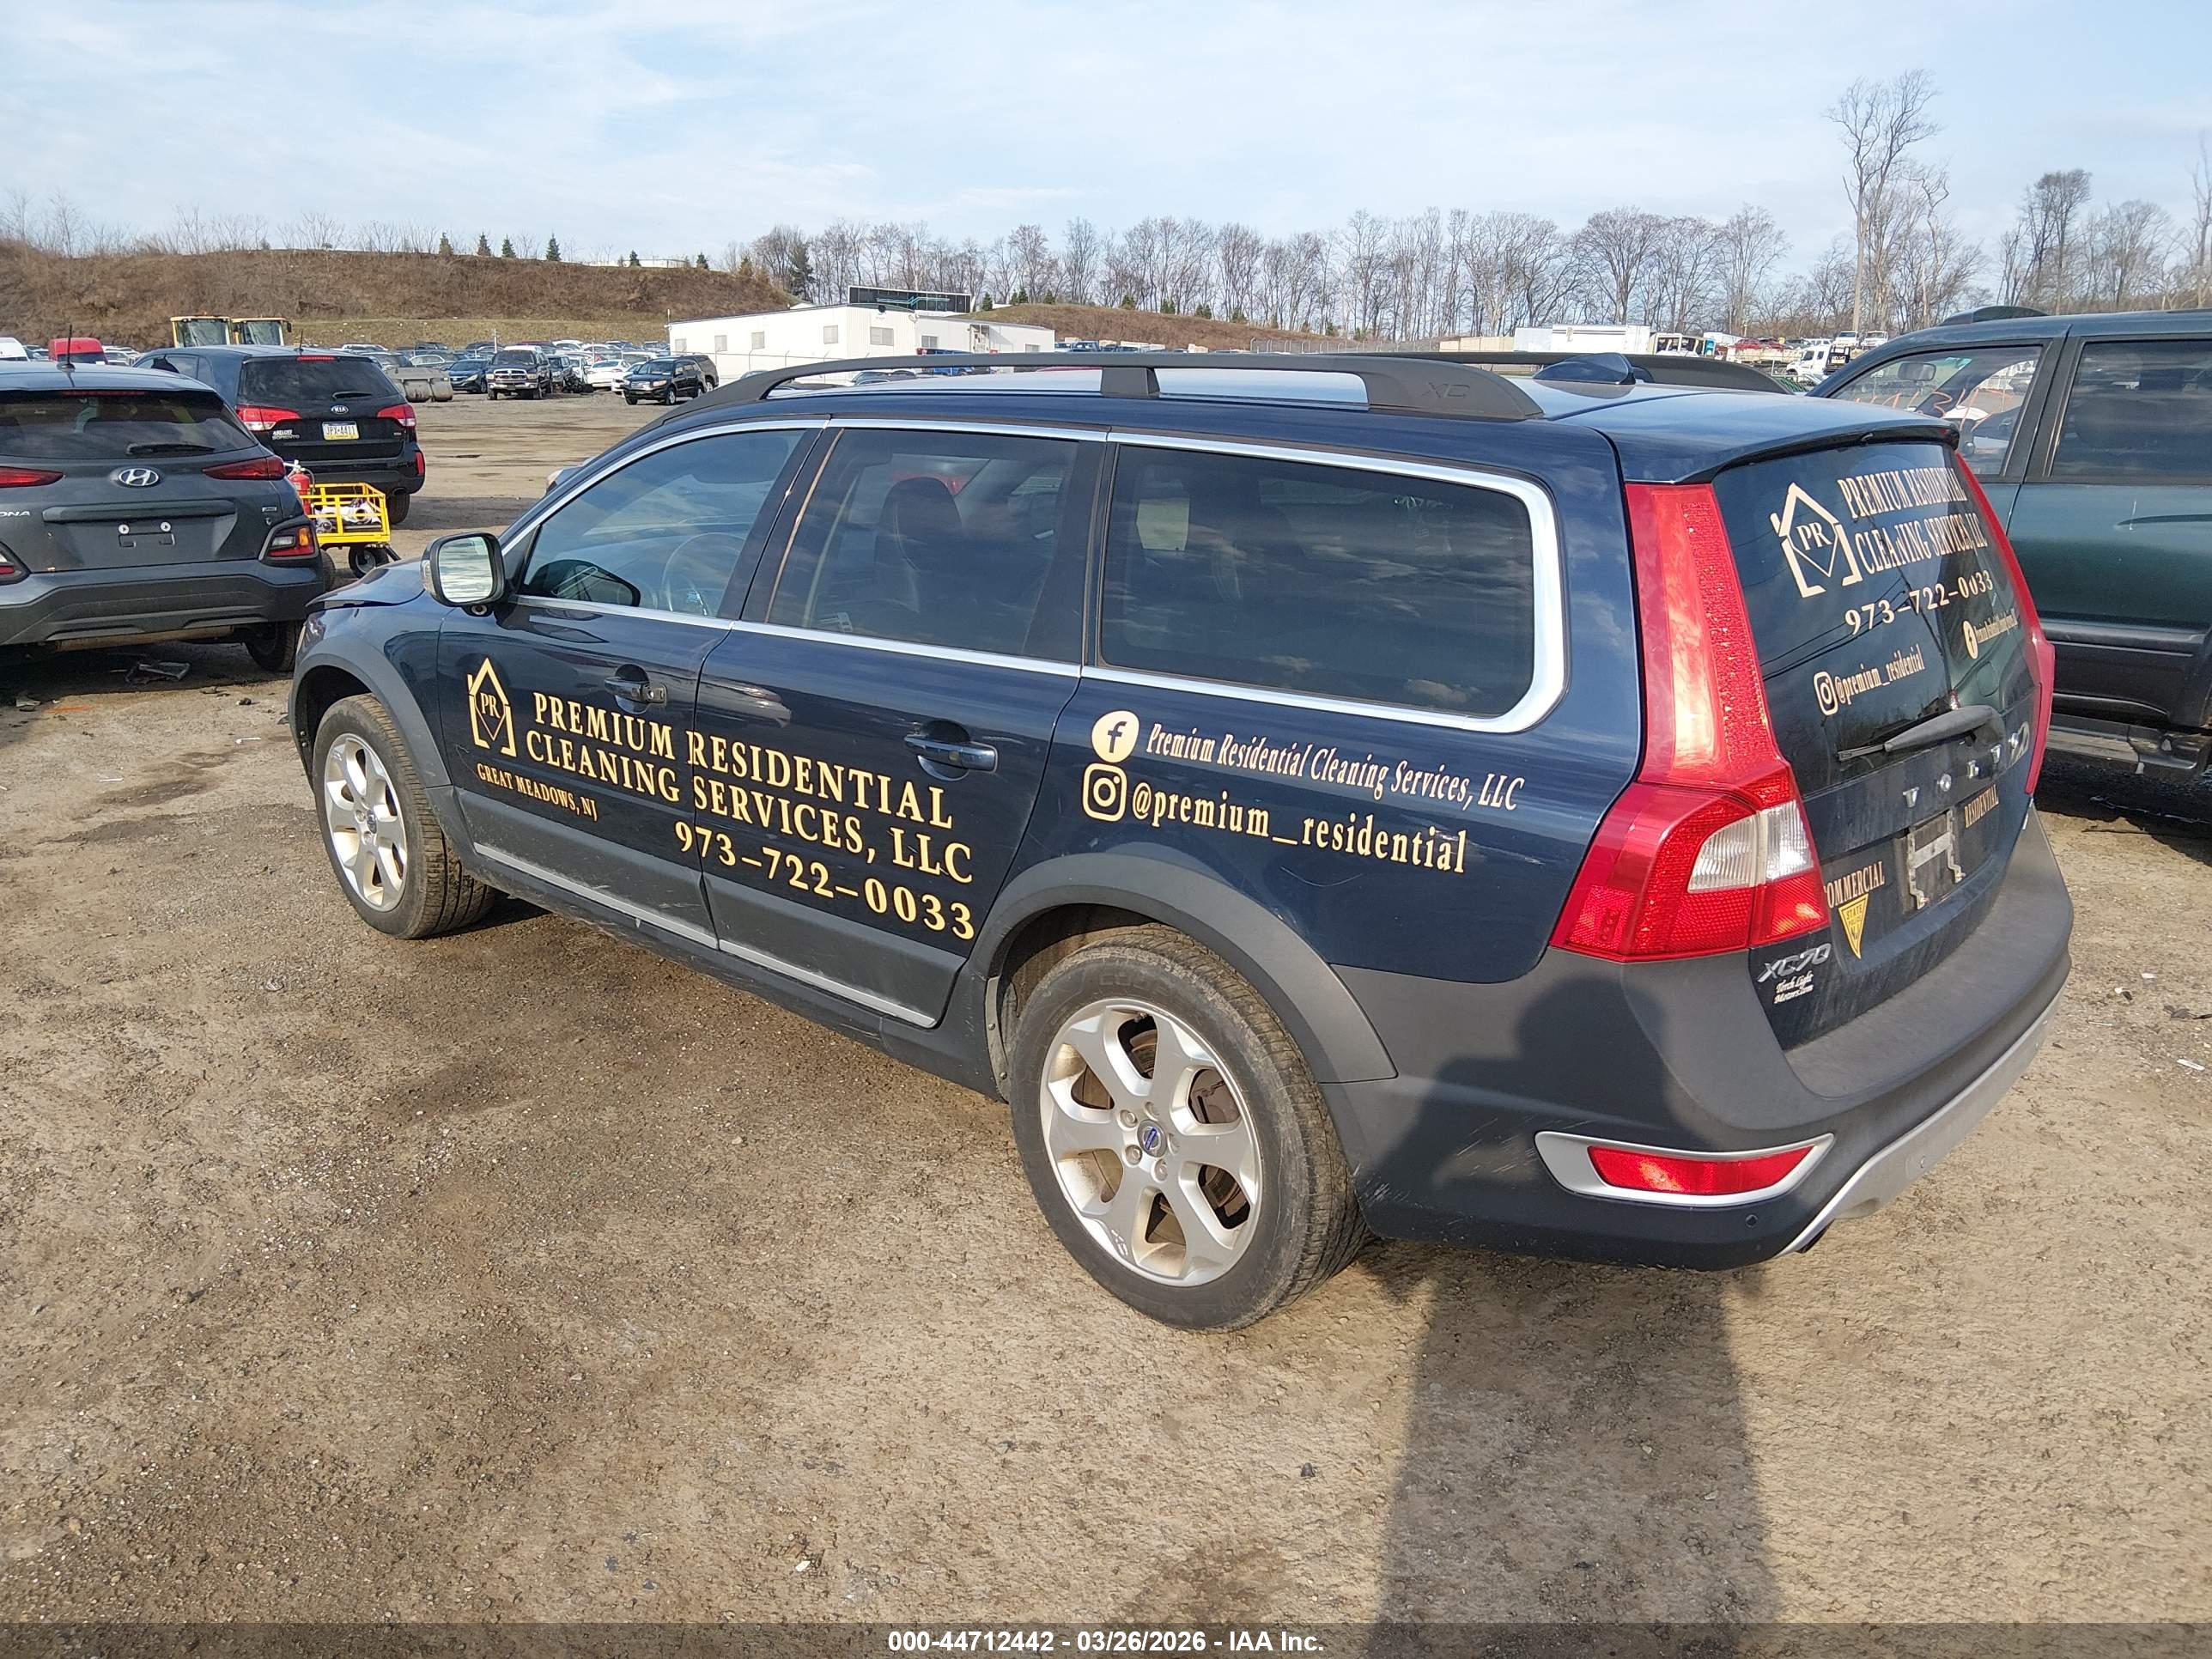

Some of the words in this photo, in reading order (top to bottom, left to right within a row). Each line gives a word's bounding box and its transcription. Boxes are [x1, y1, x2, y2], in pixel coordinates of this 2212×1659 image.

[1837, 470, 1912, 519] PREMIUM
[1795, 521, 1832, 550] PR
[1855, 520, 1932, 574] CLEANING
[1845, 570, 1993, 635] 973-722-0033
[480, 692, 501, 719] PR
[532, 691, 676, 760] PREMIUM
[686, 729, 954, 830] RESIDENTIAL
[1146, 723, 1213, 763] Premium
[1217, 733, 1308, 778] Residential
[1310, 747, 1386, 799] Cleaning
[1390, 760, 1473, 811] Services,
[1478, 773, 1525, 811] LLC
[477, 763, 514, 790] GREAT
[514, 775, 580, 816] MEADOWS,
[580, 796, 599, 822] NJ
[526, 730, 680, 803] CLEANING
[693, 775, 877, 864] SERVICES,
[890, 826, 974, 884] LLC
[1964, 783, 2000, 830] RESIDENTIAL
[1132, 785, 1468, 873] @premium_residential
[674, 820, 975, 941] 973-722-0033
[1823, 860, 1885, 908] OMMERCIAL
[1757, 943, 1832, 982] XC70
